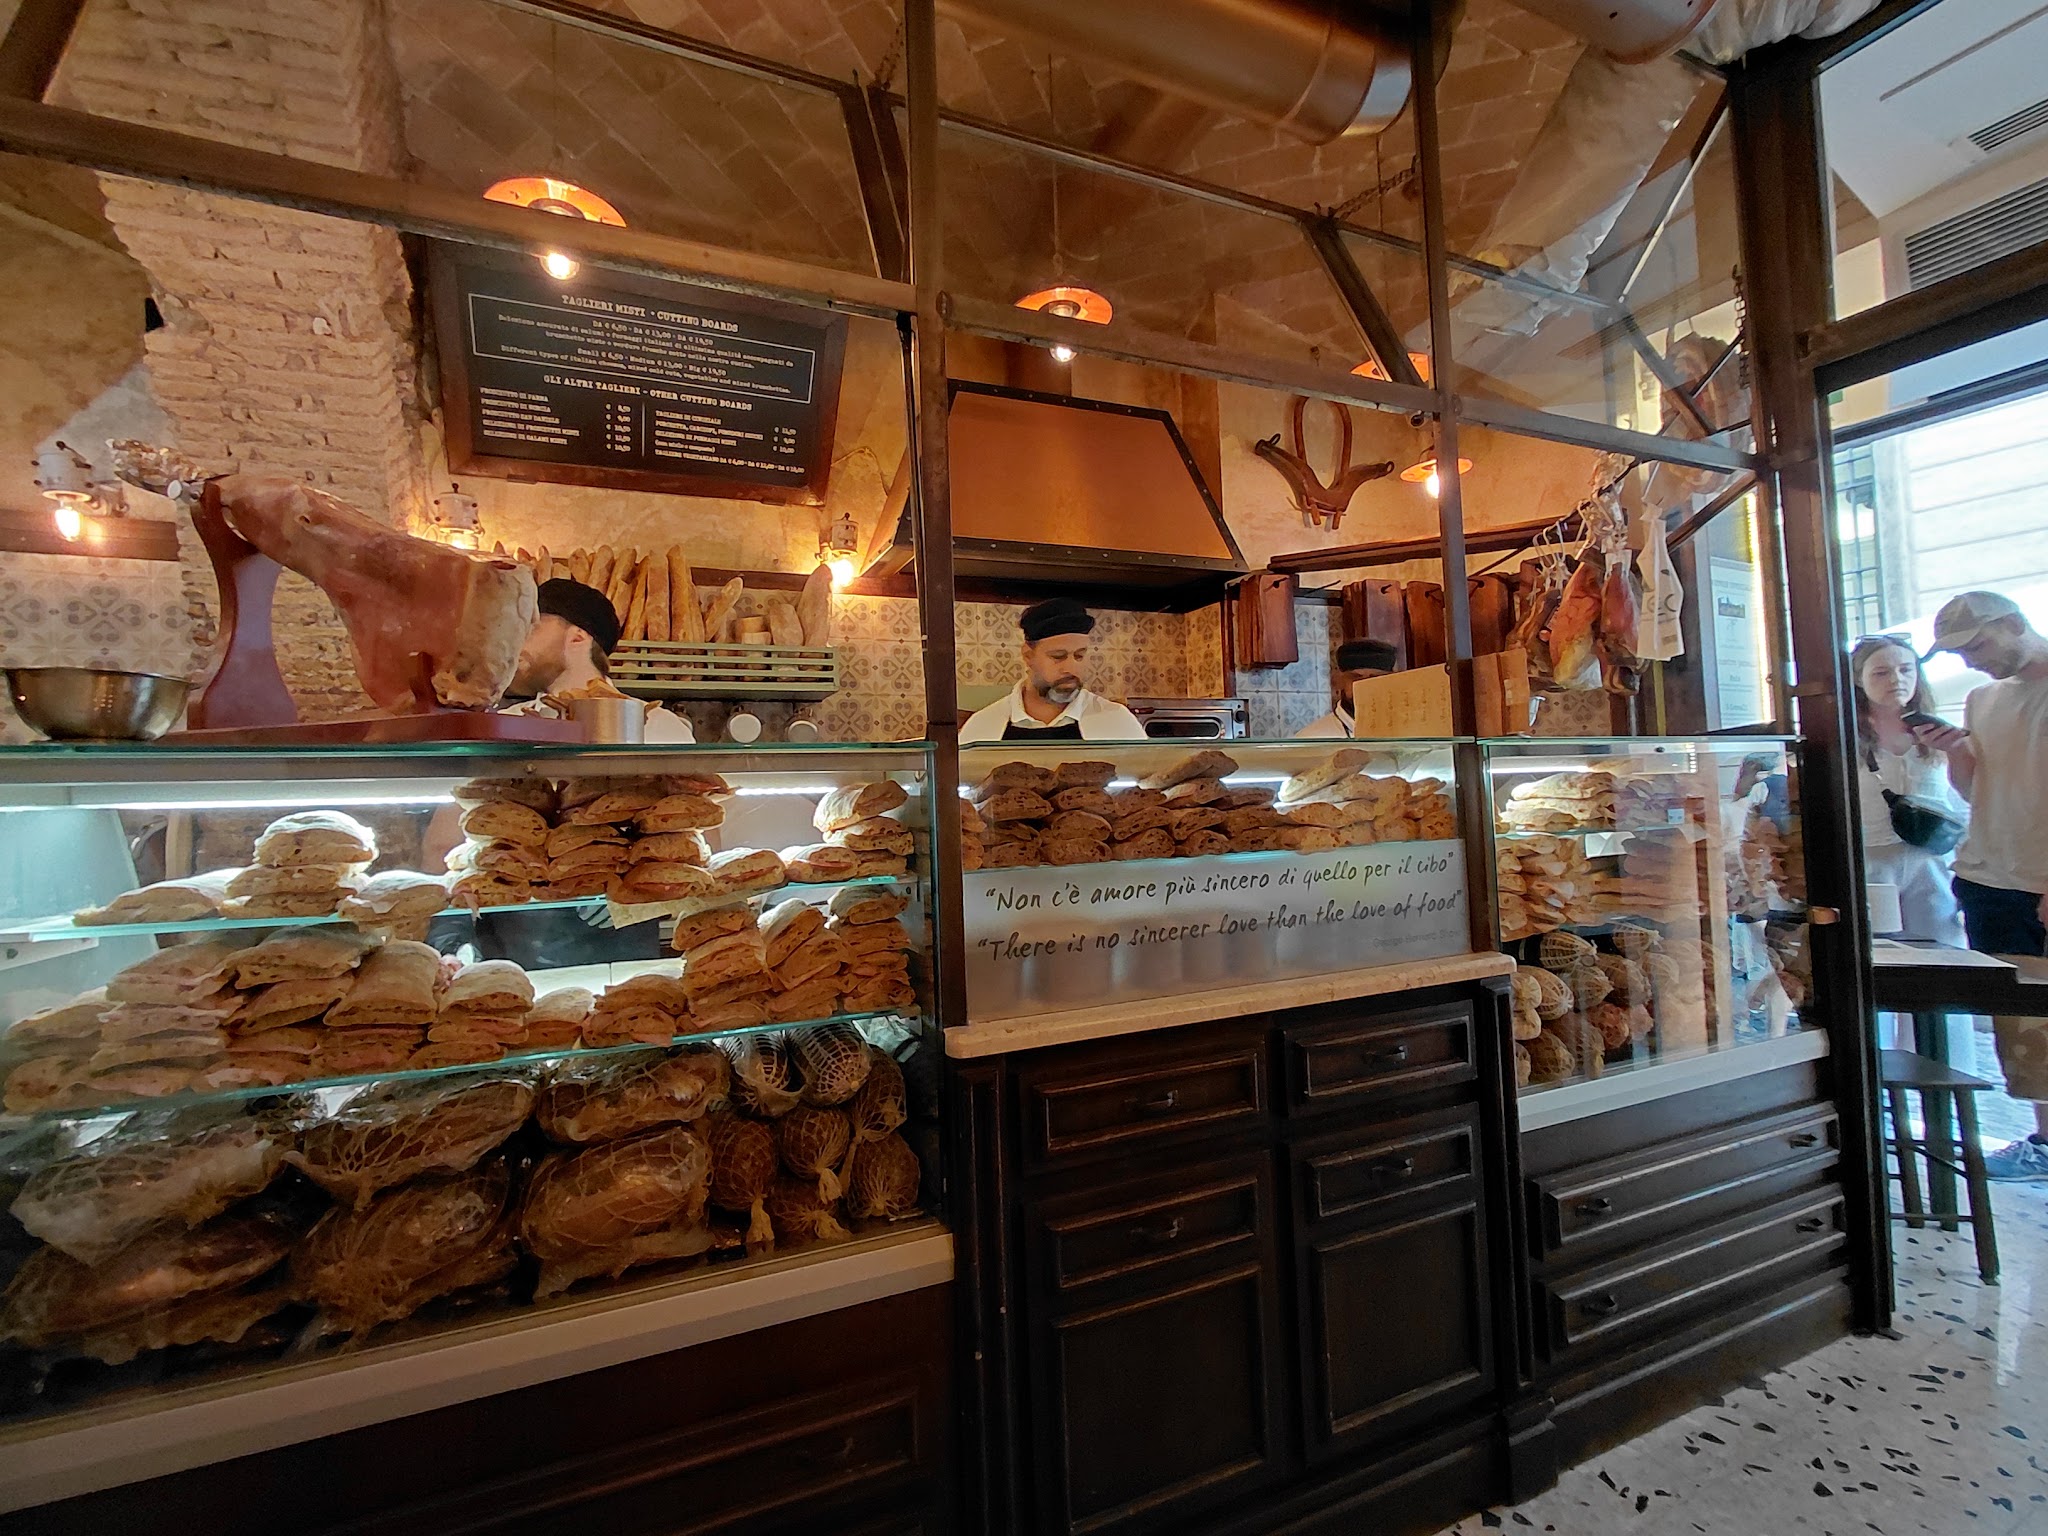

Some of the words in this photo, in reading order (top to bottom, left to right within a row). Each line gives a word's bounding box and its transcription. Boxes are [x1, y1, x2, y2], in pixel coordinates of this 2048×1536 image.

[562, 295, 613, 312] TAGLIERI
[616, 303, 646, 318] MISTI
[657, 310, 700, 326] CUTTING
[702, 318, 739, 333] BOARDS
[544, 375, 562, 385] GLI
[564, 378, 594, 389] ALTRI
[595, 382, 641, 395] TAGLIERI
[650, 390, 678, 400] OTHER
[680, 394, 718, 406] CUTTING
[720, 399, 752, 411] BOARDS
[986, 886, 1041, 911] “Non
[1052, 882, 1081, 907] c'è
[1090, 882, 1157, 904] amore
[1165, 876, 1196, 905] più
[1201, 874, 1269, 894] sincero
[1278, 868, 1295, 886] di
[1303, 860, 1357, 891] quello
[1364, 863, 1392, 886] per
[1398, 855, 1413, 875] il
[1417, 852, 1454, 874] cibo”
[977, 931, 1057, 961] “There
[1067, 933, 1084, 953] is
[1095, 932, 1120, 949] no
[1128, 923, 1211, 947] sincerer
[1217, 914, 1258, 935] love
[1267, 904, 1307, 931] than
[1316, 899, 1345, 924] the
[1350, 900, 1386, 920] love
[1393, 893, 1414, 920] of
[1417, 889, 1463, 919] food”
